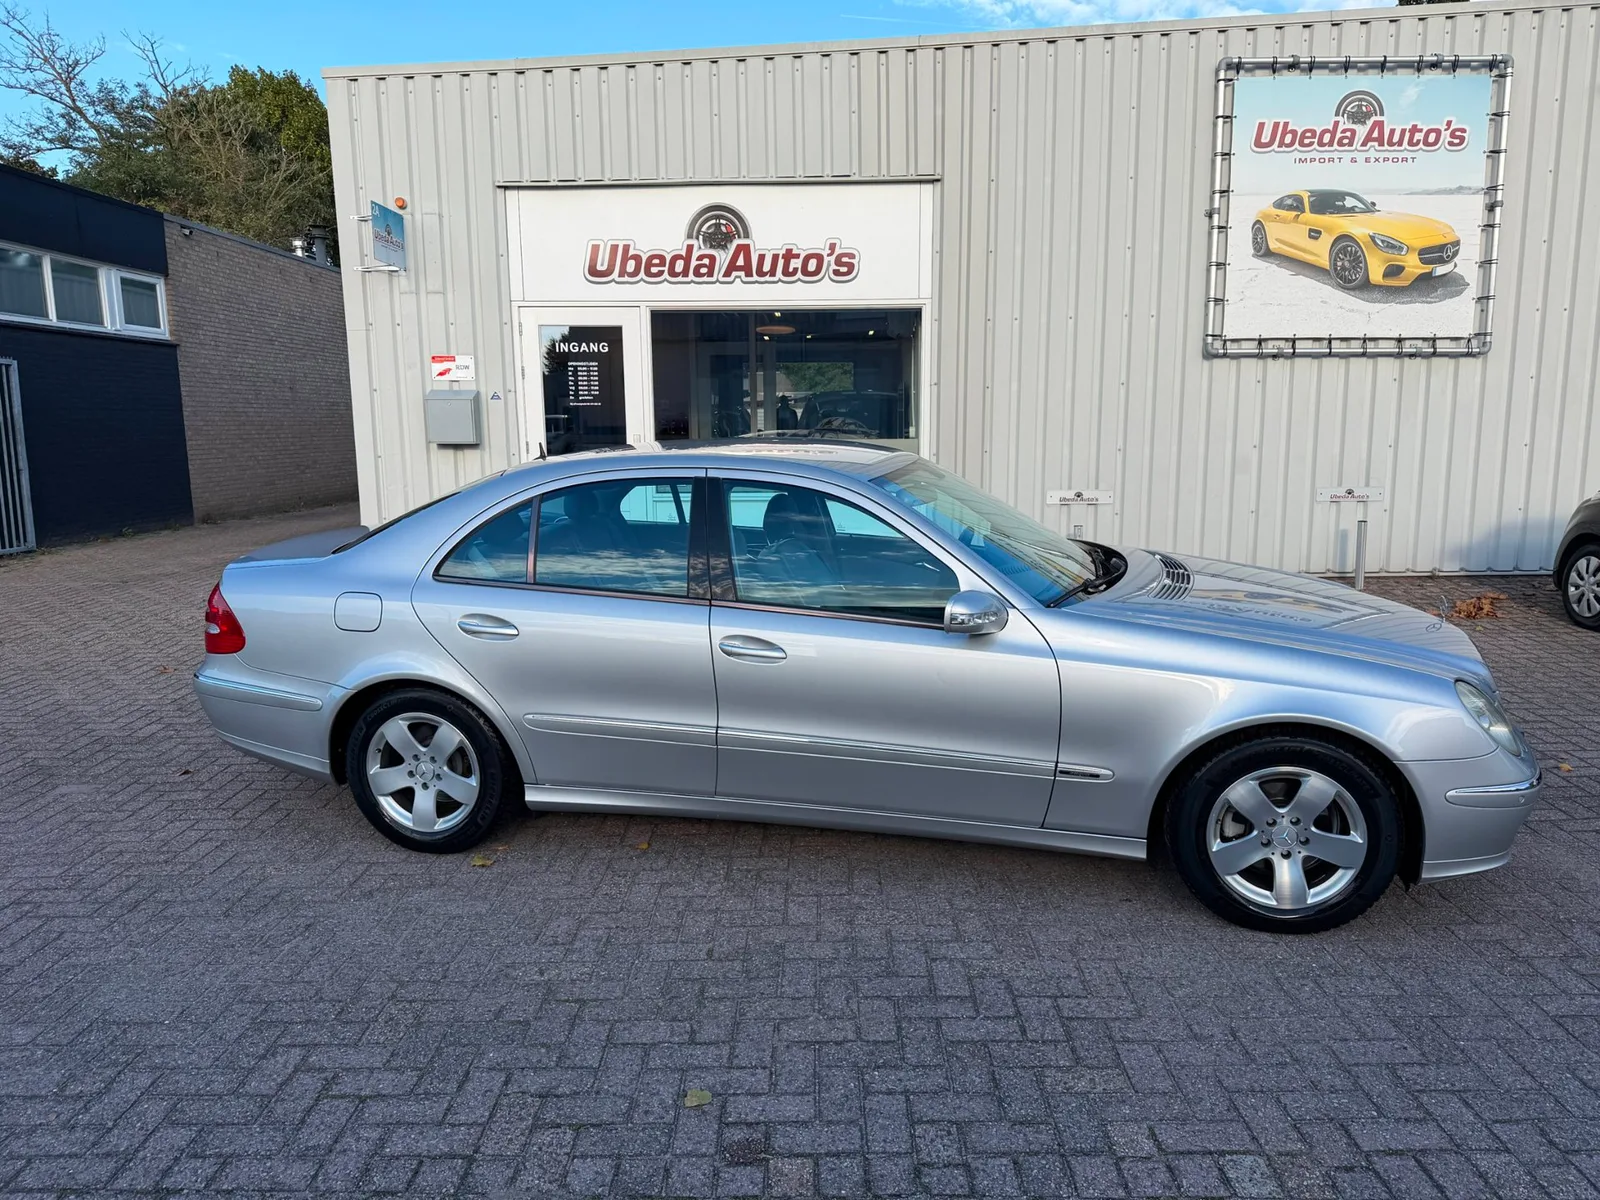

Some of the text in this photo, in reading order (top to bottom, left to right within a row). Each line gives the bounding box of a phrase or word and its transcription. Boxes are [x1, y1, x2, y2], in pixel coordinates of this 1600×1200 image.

[1253, 119, 1468, 149] Ubeda Auto's
[1293, 156, 1418, 164] IMPORT & EXPORT
[586, 242, 857, 279] Ubeda Auto's
[555, 342, 609, 353] INGANG
